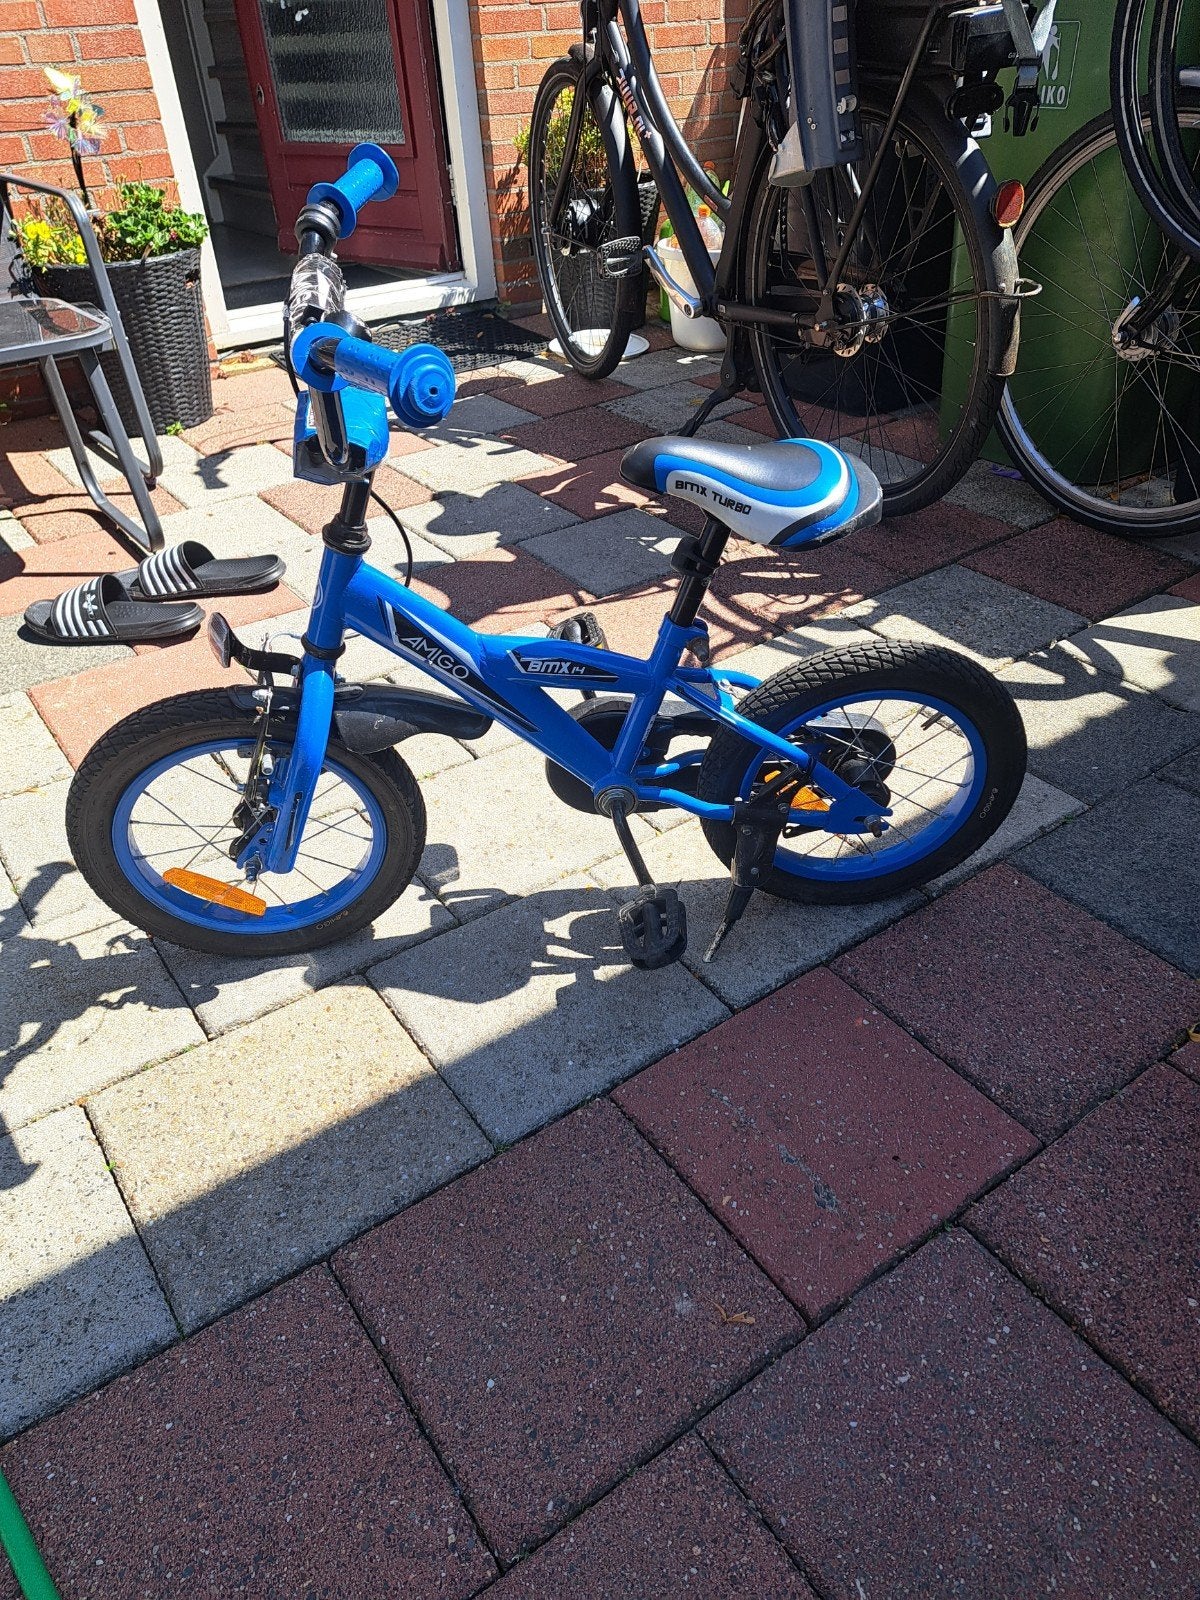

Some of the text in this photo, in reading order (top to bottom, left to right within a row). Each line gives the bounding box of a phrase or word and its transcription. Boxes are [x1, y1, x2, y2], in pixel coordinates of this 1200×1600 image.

[1040, 85, 1066, 105] IKO
[675, 480, 752, 515] BMX TURBO
[400, 636, 470, 680] AMIGO
[527, 660, 586, 675] BMX 14
